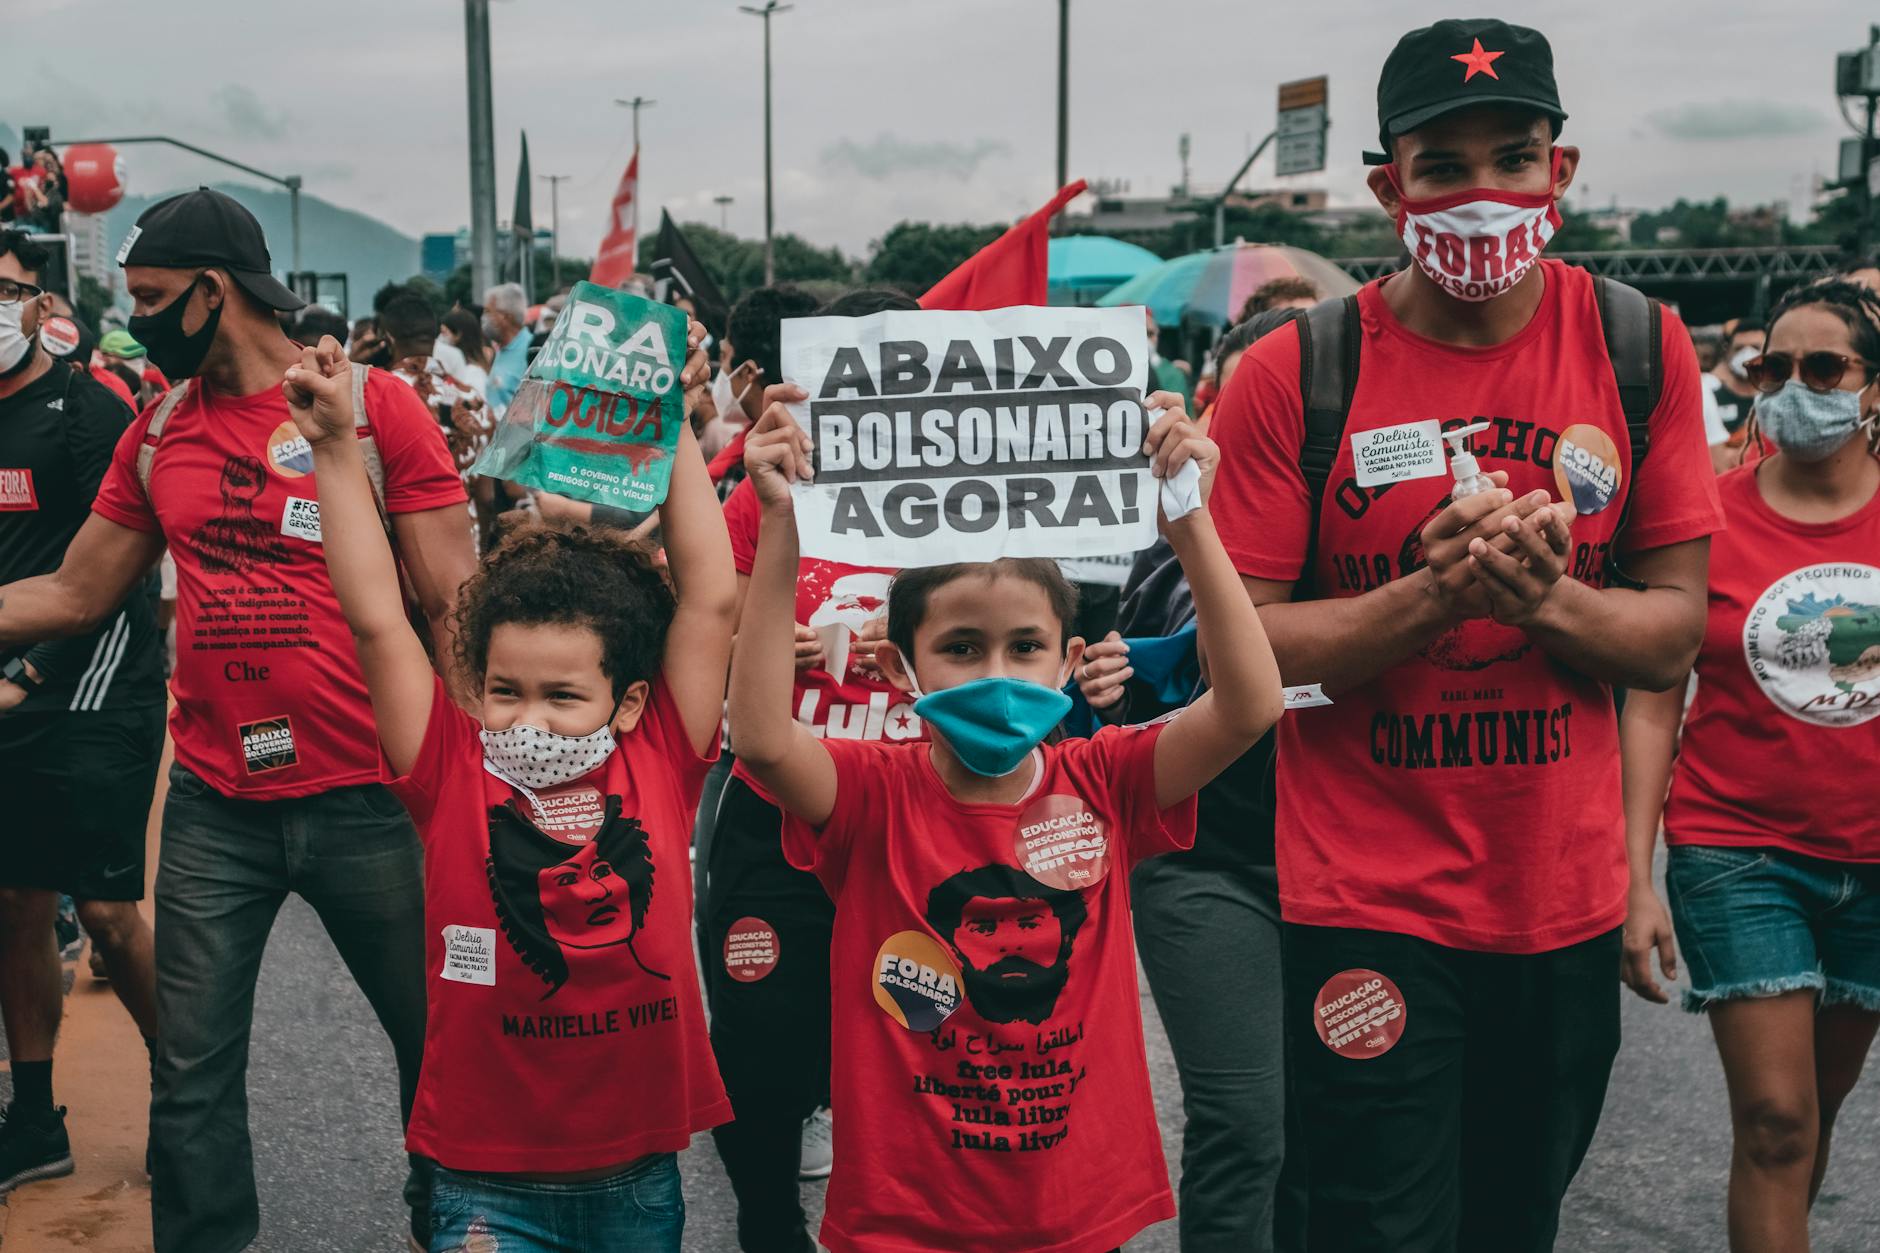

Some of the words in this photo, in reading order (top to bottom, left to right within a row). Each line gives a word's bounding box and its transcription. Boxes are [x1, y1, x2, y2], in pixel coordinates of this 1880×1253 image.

[1414, 214, 1546, 282] FORA!
[551, 300, 670, 367] ORA
[537, 340, 674, 394] OLSONARO
[818, 336, 1133, 398] ABAIXO
[545, 380, 663, 440] OCIDA
[818, 400, 1142, 471] BOLSONARO
[1361, 438, 1434, 459] Comunista:
[1364, 455, 1390, 466] VACINA
[1392, 454, 1403, 462] NO
[1404, 449, 1428, 460] BRAÇO
[1367, 463, 1394, 474] COMIDA
[1396, 461, 1407, 469] NO
[1408, 457, 1433, 467] PRATO!
[1560, 439, 1616, 486] FORA
[1560, 455, 1612, 495] BOLSONARO!
[548, 471, 590, 488] PERIGOSO
[593, 482, 609, 493] QUE
[612, 487, 620, 495] O
[622, 489, 653, 502] VÍRUS!
[570, 466, 578, 474] O
[580, 468, 620, 484] GOVERNO
[622, 476, 629, 486] É
[631, 480, 655, 492] MAIS
[290, 511, 320, 523] BOLSON
[292, 499, 319, 514] #FO
[830, 472, 1140, 539] AGORA!
[289, 519, 320, 531] GENOC
[1796, 567, 1872, 581] PEQUENOS
[235, 598, 297, 609] indignação
[253, 627, 267, 635] no
[224, 661, 270, 682] Che
[243, 728, 290, 746] ABAIXO
[252, 737, 292, 750] GOVERNO
[1370, 702, 1572, 769] COMMUNIST
[245, 743, 294, 758] BOLSONARO
[534, 803, 600, 816] DSCONSTRÓI
[1021, 811, 1093, 838] EDUCAÇÃO
[1025, 825, 1099, 849] DESCONSTRÓI
[729, 931, 772, 943] EDUCAÇÃO
[880, 954, 956, 997] FORA
[879, 974, 955, 1007] BOLSONARO!
[1319, 978, 1382, 1018] EDUCAÇÃO
[503, 1010, 620, 1039] MARIELLE
[629, 997, 678, 1029] VIVE!
[1325, 989, 1389, 1028] DESCONSTRÓI
[957, 1060, 1013, 1080] free
[1020, 1058, 1072, 1080] lula
[913, 1075, 1001, 1101] liberté
[1007, 1082, 1065, 1105] pour
[952, 1103, 1012, 1126] lula
[952, 1129, 1012, 1152] lula
